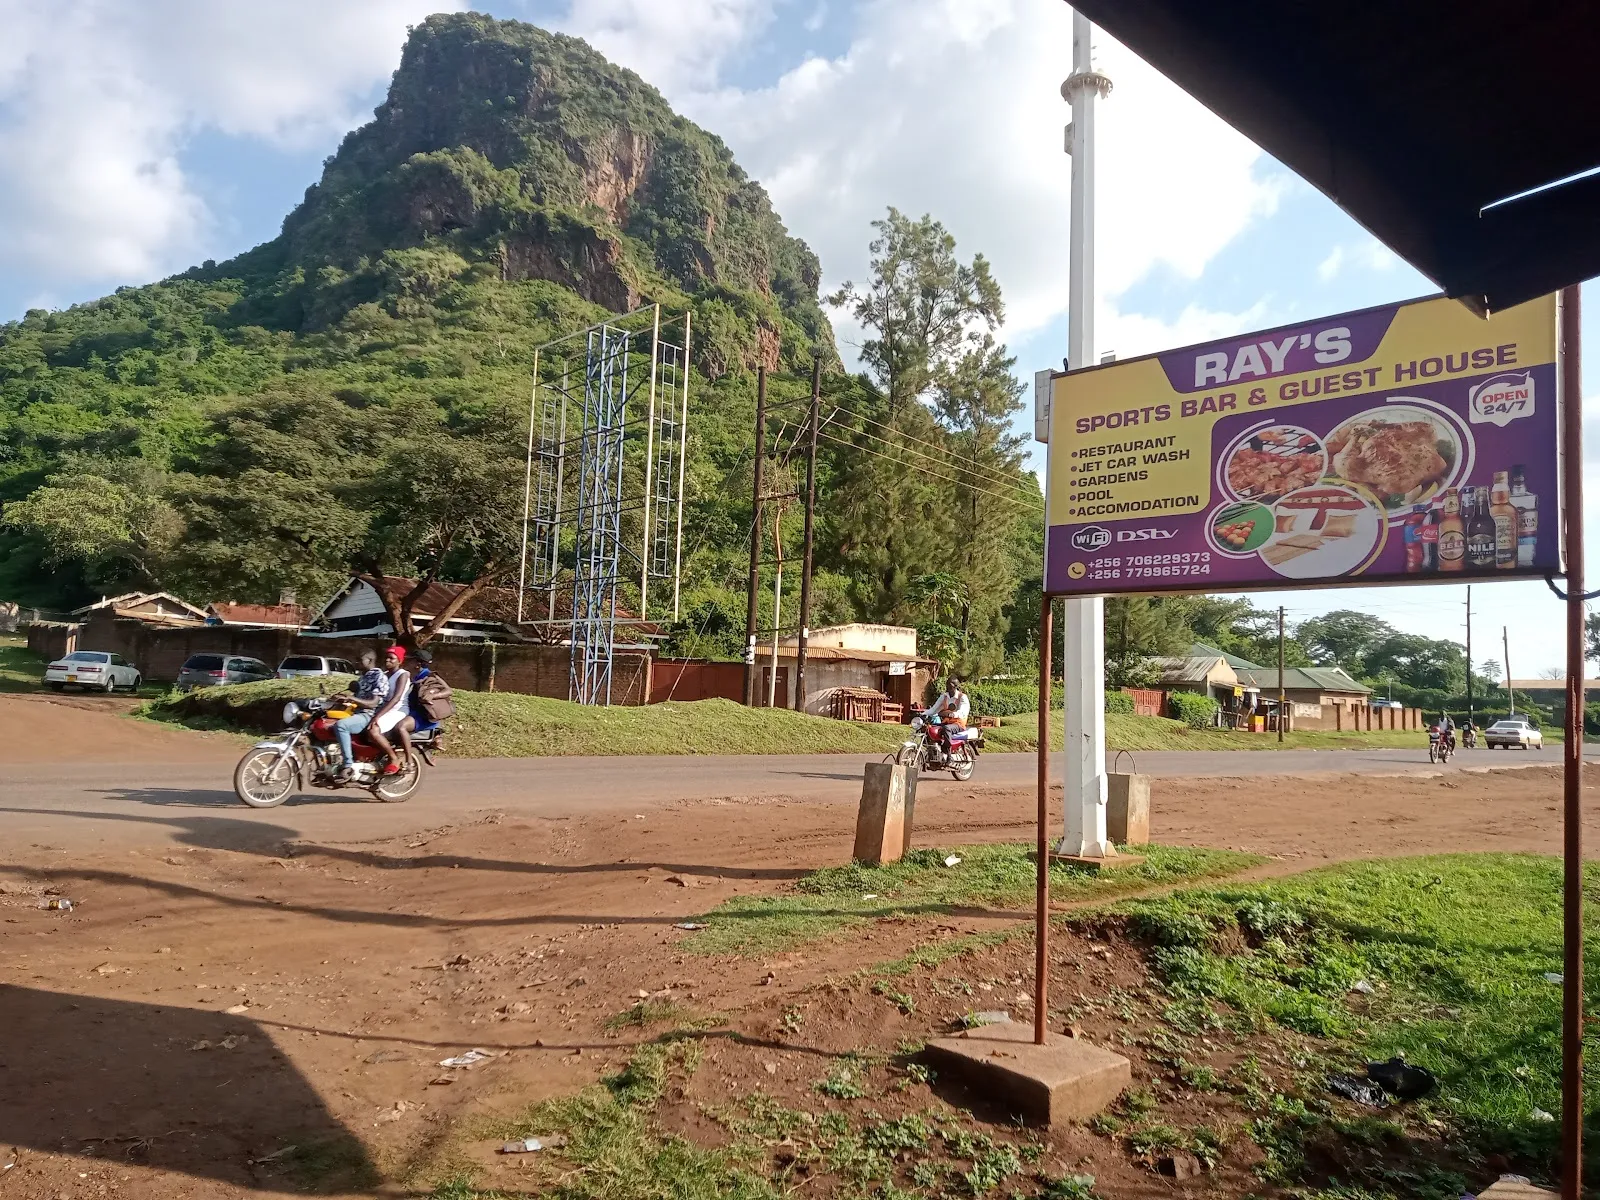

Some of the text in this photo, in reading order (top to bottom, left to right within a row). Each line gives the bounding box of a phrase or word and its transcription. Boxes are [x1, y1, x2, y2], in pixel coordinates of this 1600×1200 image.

[1194, 327, 1352, 388] RAY'S
[1076, 343, 1517, 434] SPORTS BAR & GUEST HOUSE
[1482, 389, 1529, 404] OPEN
[1483, 400, 1527, 416] 24/7
[1079, 435, 1177, 459] RESTAURANT
[1078, 449, 1190, 473] JET CAR WASH
[1078, 470, 1149, 488] GARDENS
[1077, 489, 1114, 503] POOL
[1077, 495, 1199, 517] ACCOMODATION
[1440, 540, 1465, 550] BELL
[1468, 543, 1495, 552] NILE
[1087, 552, 1211, 569] +256 706229373
[1087, 564, 1211, 580] +256 779965724
